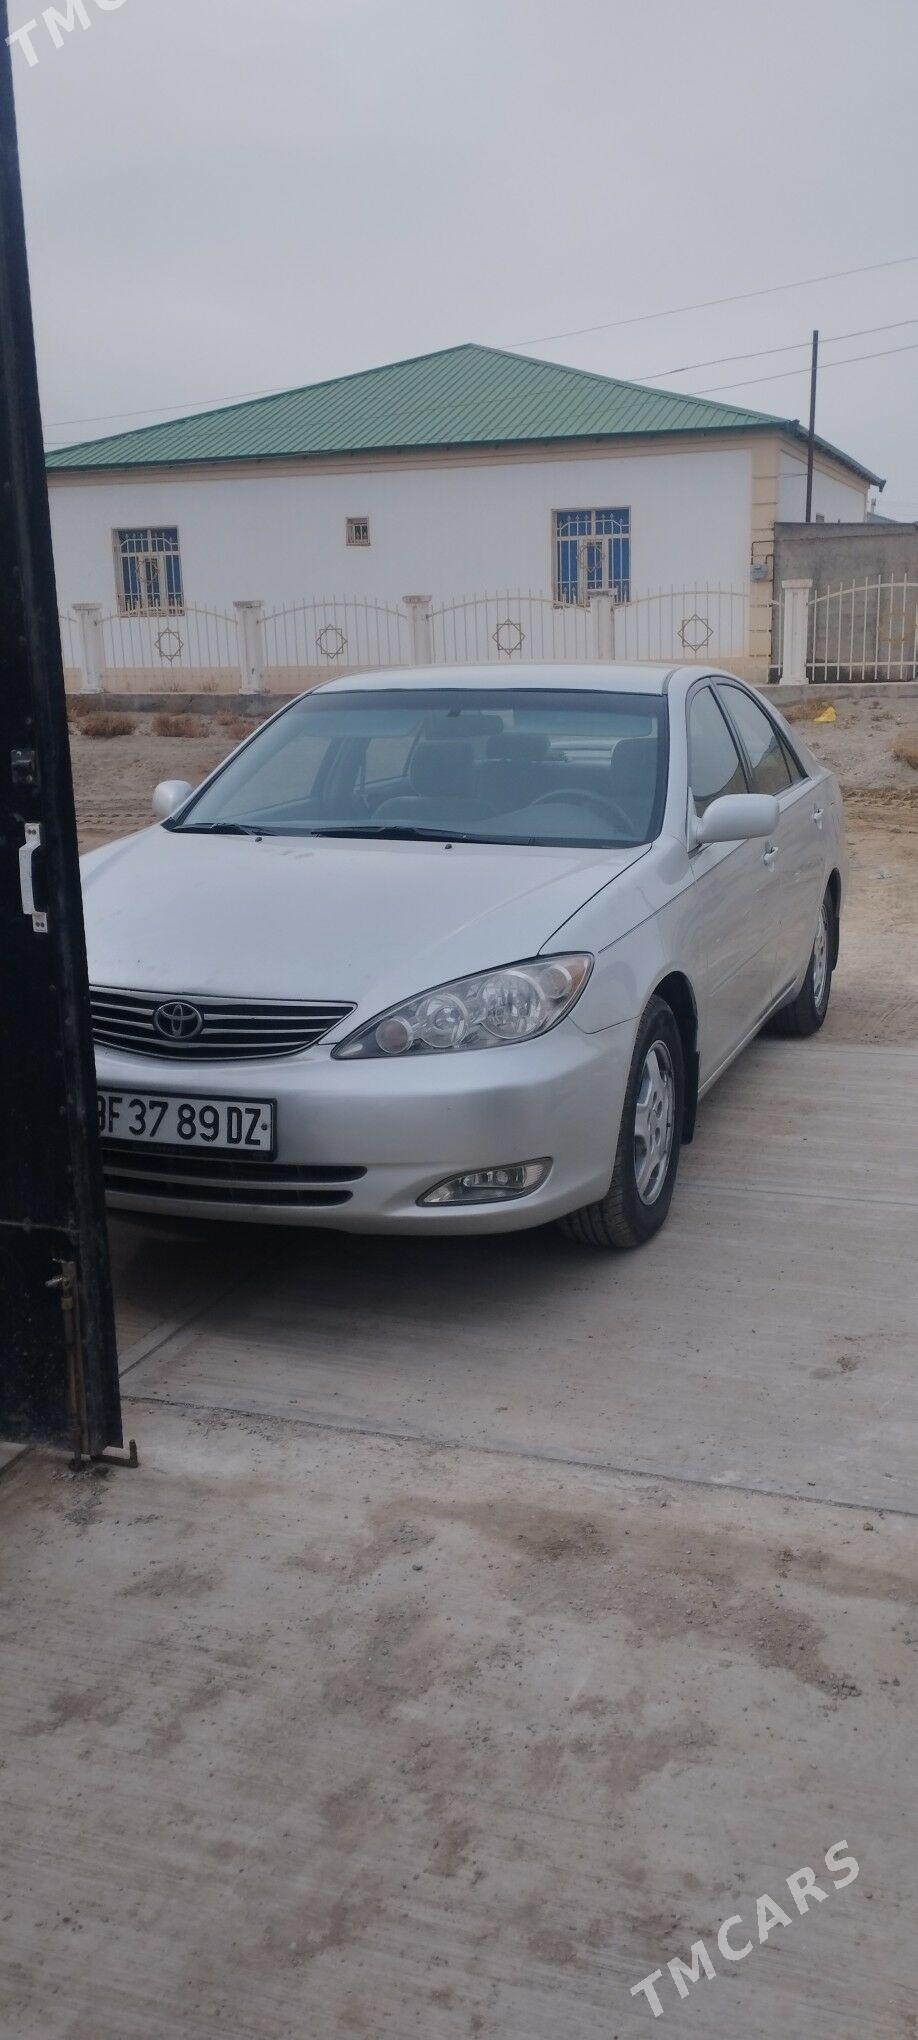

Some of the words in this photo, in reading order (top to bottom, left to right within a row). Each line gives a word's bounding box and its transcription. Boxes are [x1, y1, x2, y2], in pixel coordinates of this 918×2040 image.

[129, 1099, 168, 1137] 37
[177, 1104, 219, 1142] 89
[227, 1106, 261, 1146] DZ
